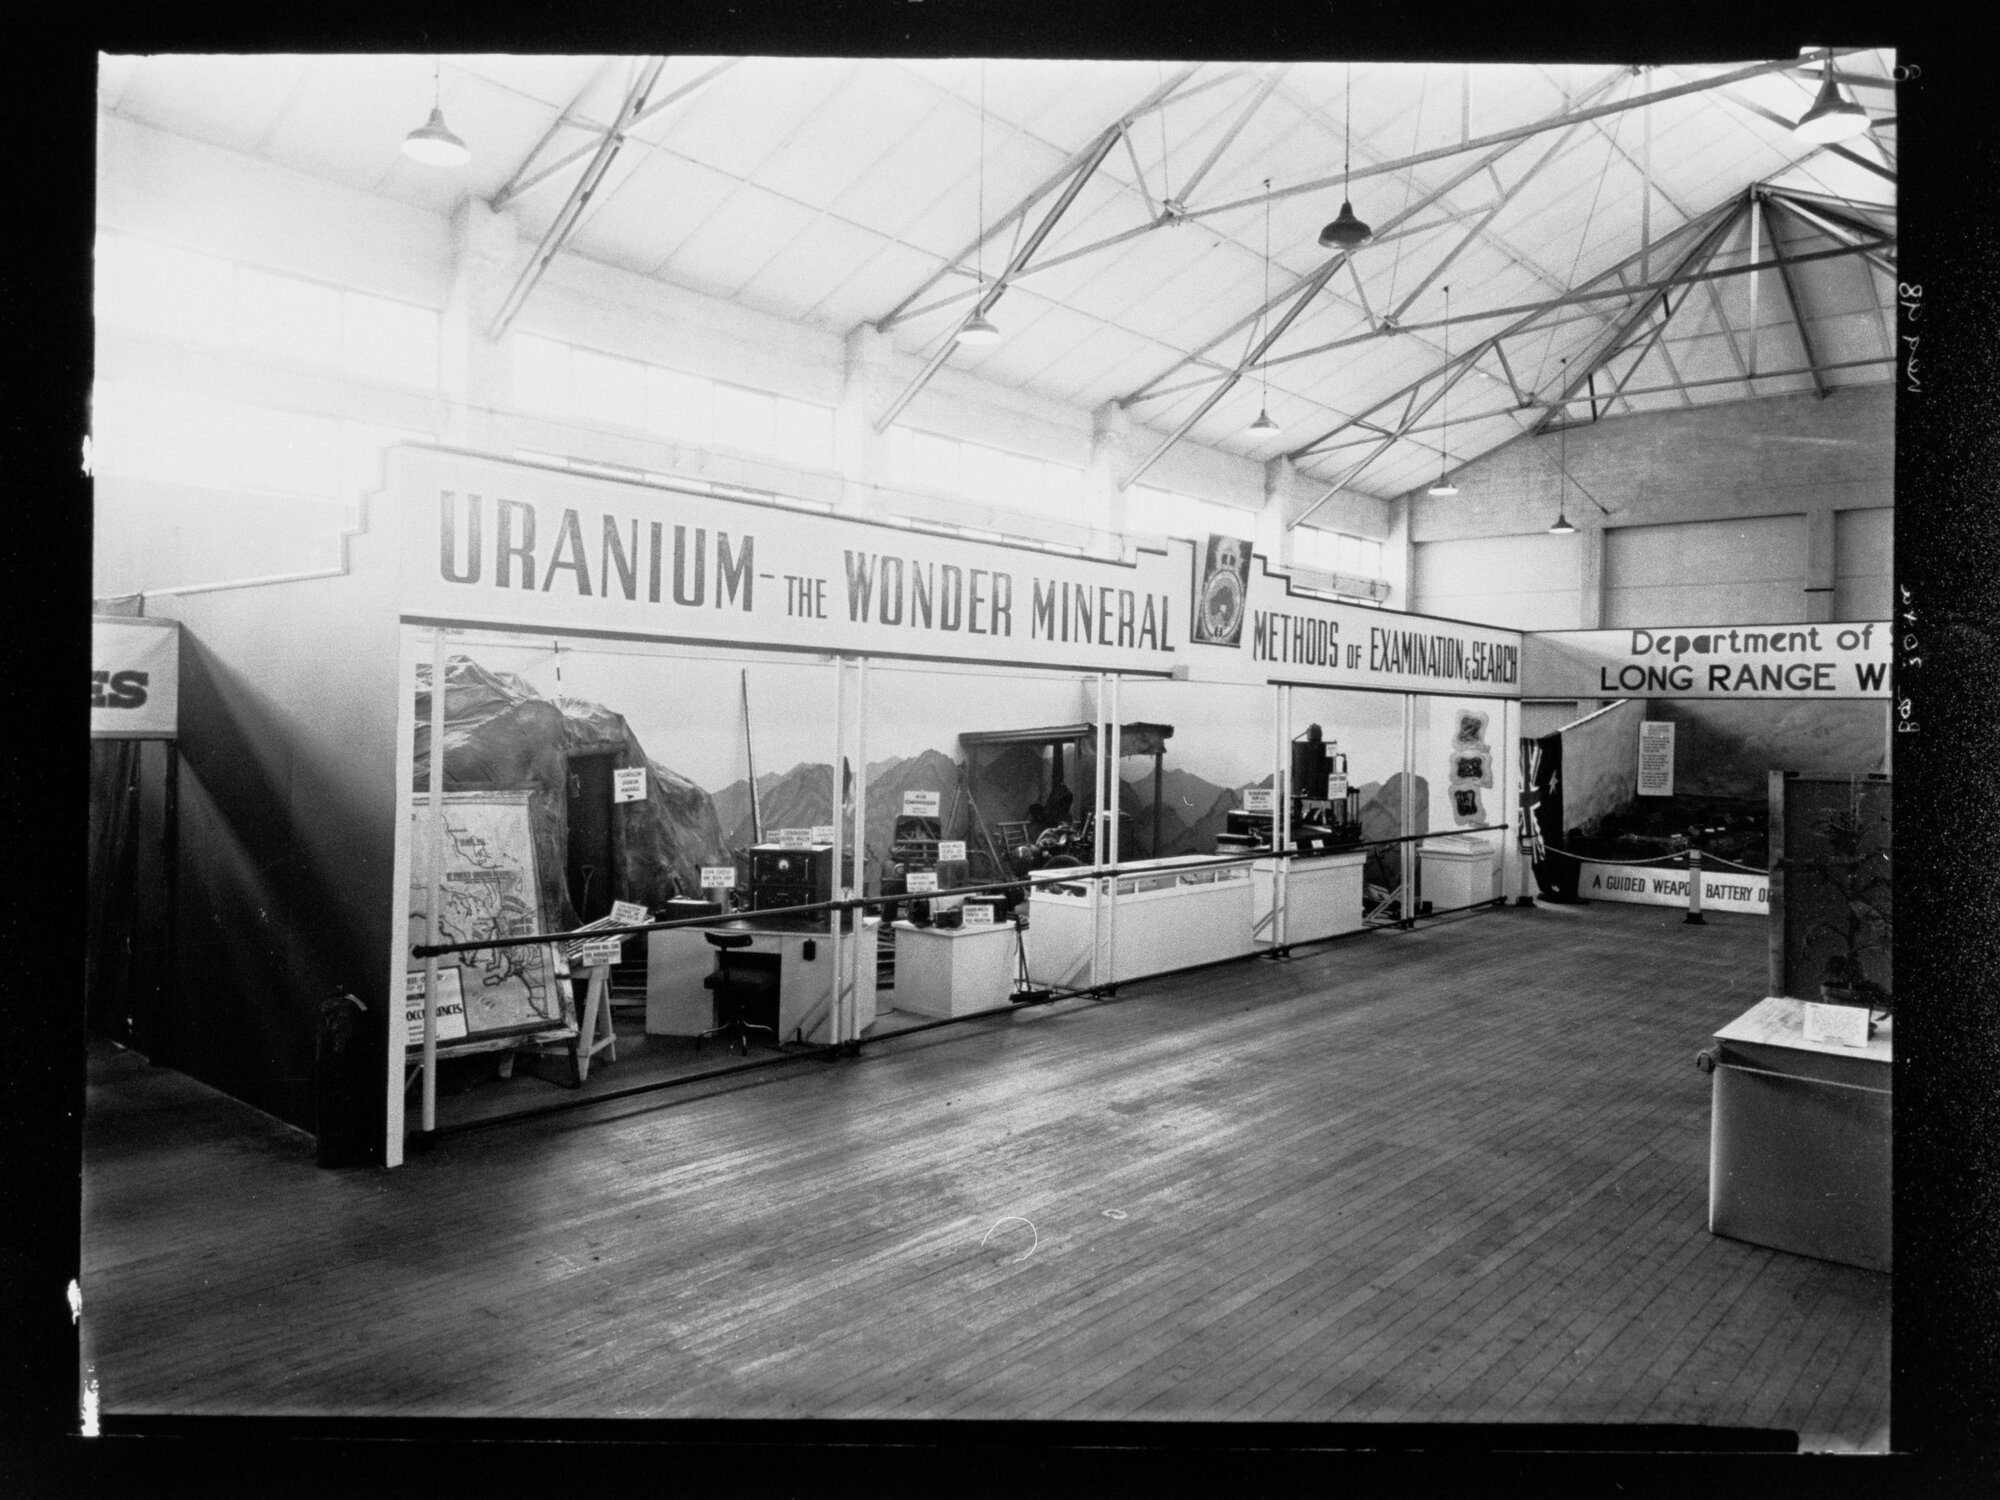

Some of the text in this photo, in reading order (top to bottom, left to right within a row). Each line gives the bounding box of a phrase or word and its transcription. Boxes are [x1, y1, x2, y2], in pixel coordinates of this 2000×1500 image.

[440, 489, 755, 613] URANIUM
[784, 575, 828, 619] THE
[843, 549, 1012, 638] WONDER
[1031, 577, 1176, 653] MINERAL
[1252, 610, 1339, 668] METHODS
[1346, 643, 1362, 670] OF
[1370, 626, 1464, 680] EXAMINATION
[1472, 640, 1518, 684] SEARCH
[1631, 625, 1823, 663] Department
[1836, 623, 1875, 651] of
[1600, 662, 1893, 692] LONG RANGE W
[1592, 875, 1601, 889] A
[1606, 875, 1646, 893] GUIDED
[1653, 879, 1691, 897] WEAPO
[1706, 883, 1754, 901] BATTERY
